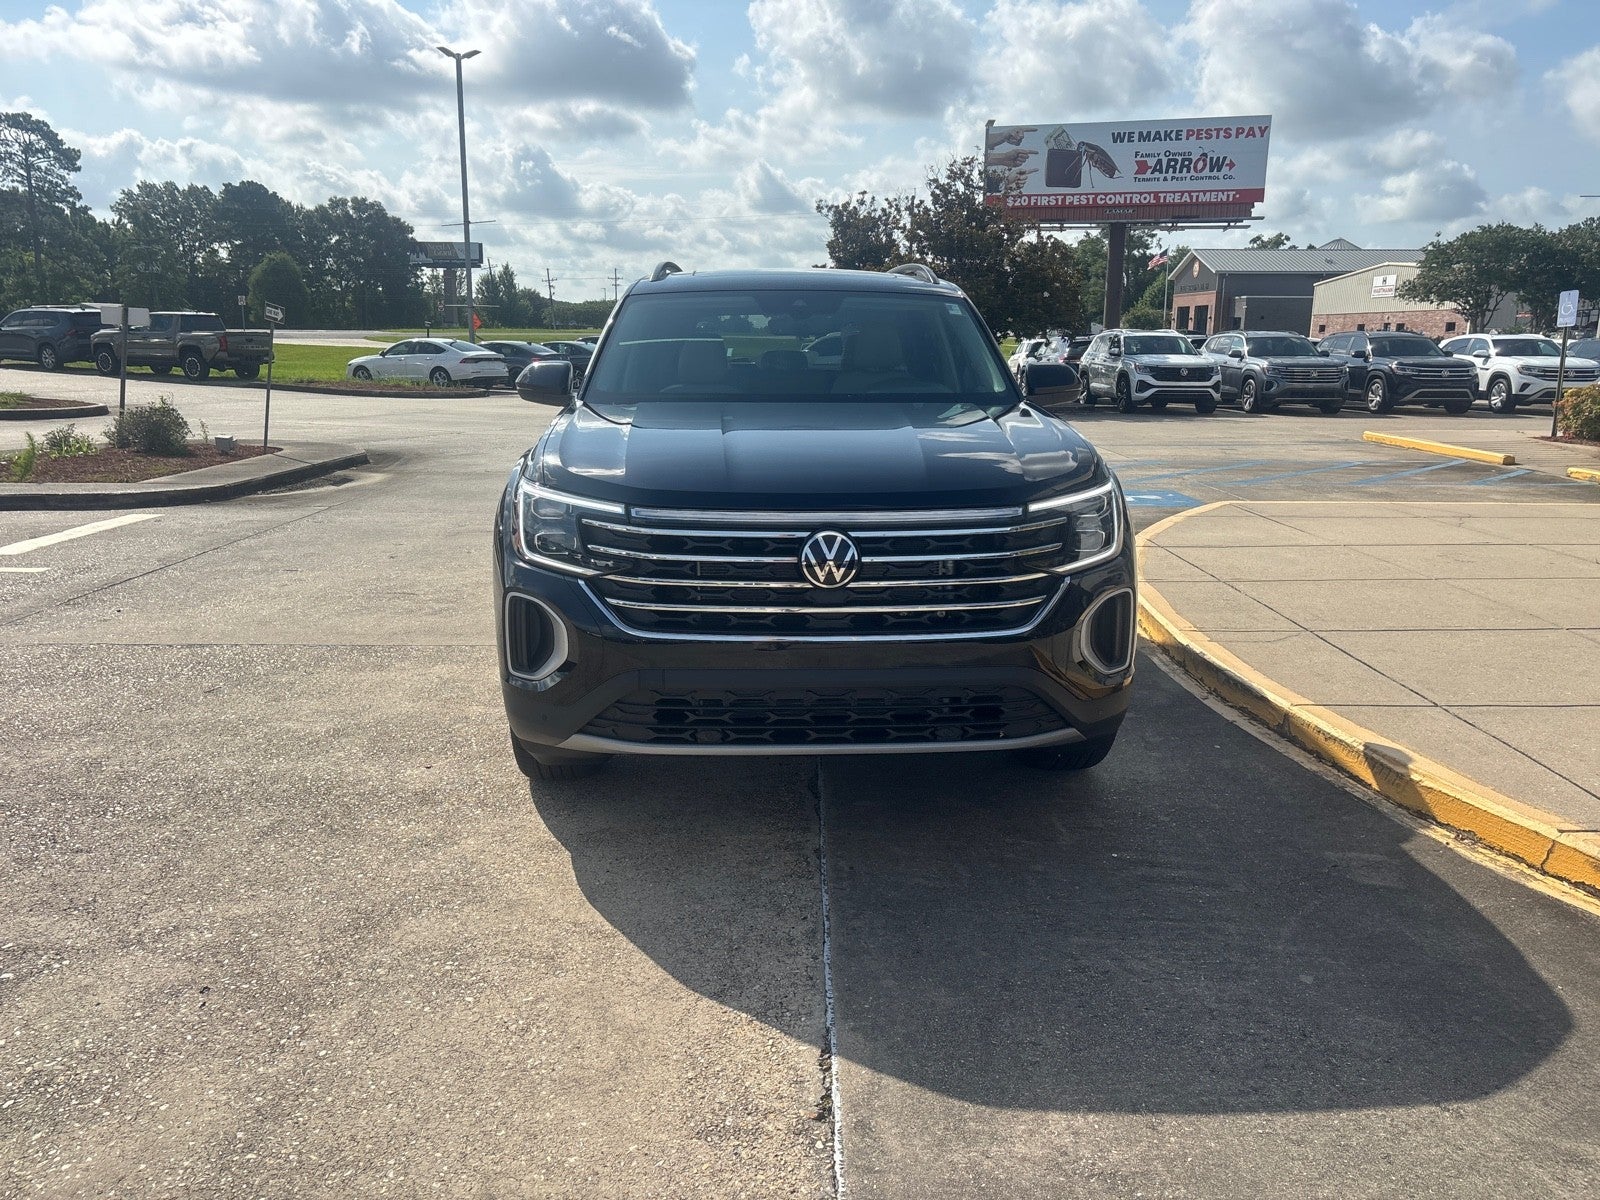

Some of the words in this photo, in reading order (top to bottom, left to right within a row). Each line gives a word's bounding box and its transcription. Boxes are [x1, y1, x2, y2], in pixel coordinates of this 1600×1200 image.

[1111, 131, 1135, 144] WE
[1137, 129, 1184, 143] MAKE
[1185, 127, 1233, 141] PESTS
[1235, 125, 1270, 139] PAY
[1150, 155, 1228, 175] ARROW
[1006, 194, 1029, 207] $20
[1030, 192, 1064, 206] FIRST
[1065, 194, 1096, 206] PEST
[1096, 192, 1156, 205] CONTROL
